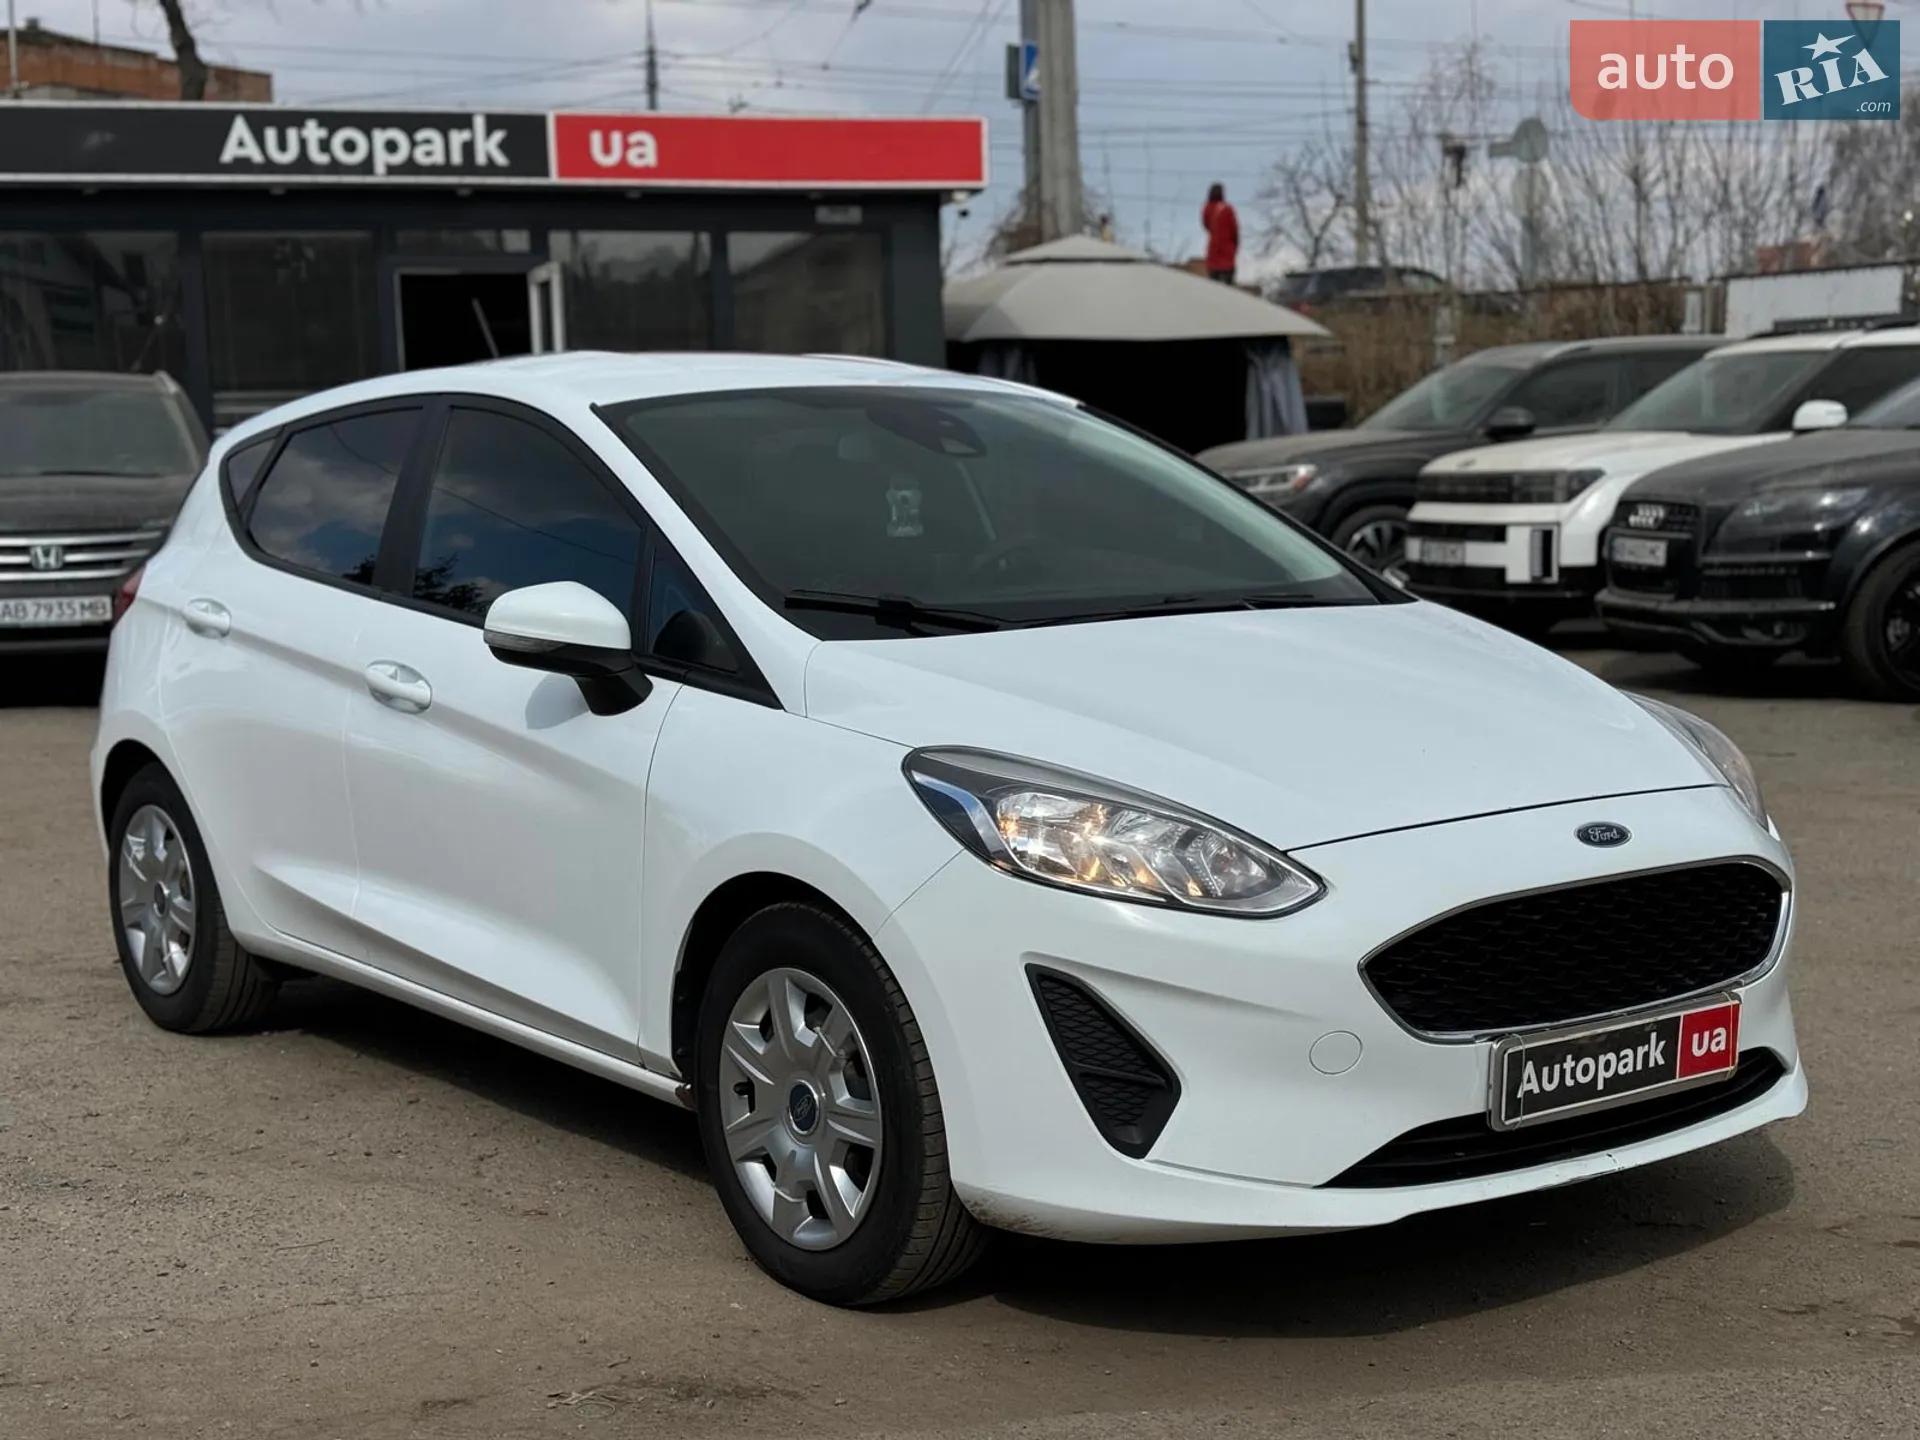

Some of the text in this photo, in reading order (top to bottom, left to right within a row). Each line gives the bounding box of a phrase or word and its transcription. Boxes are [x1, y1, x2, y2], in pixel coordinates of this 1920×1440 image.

[219, 113, 658, 176] Autopark ua
[1587, 826, 1620, 842] Ford
[1516, 1026, 1727, 1099] Autopark ua
